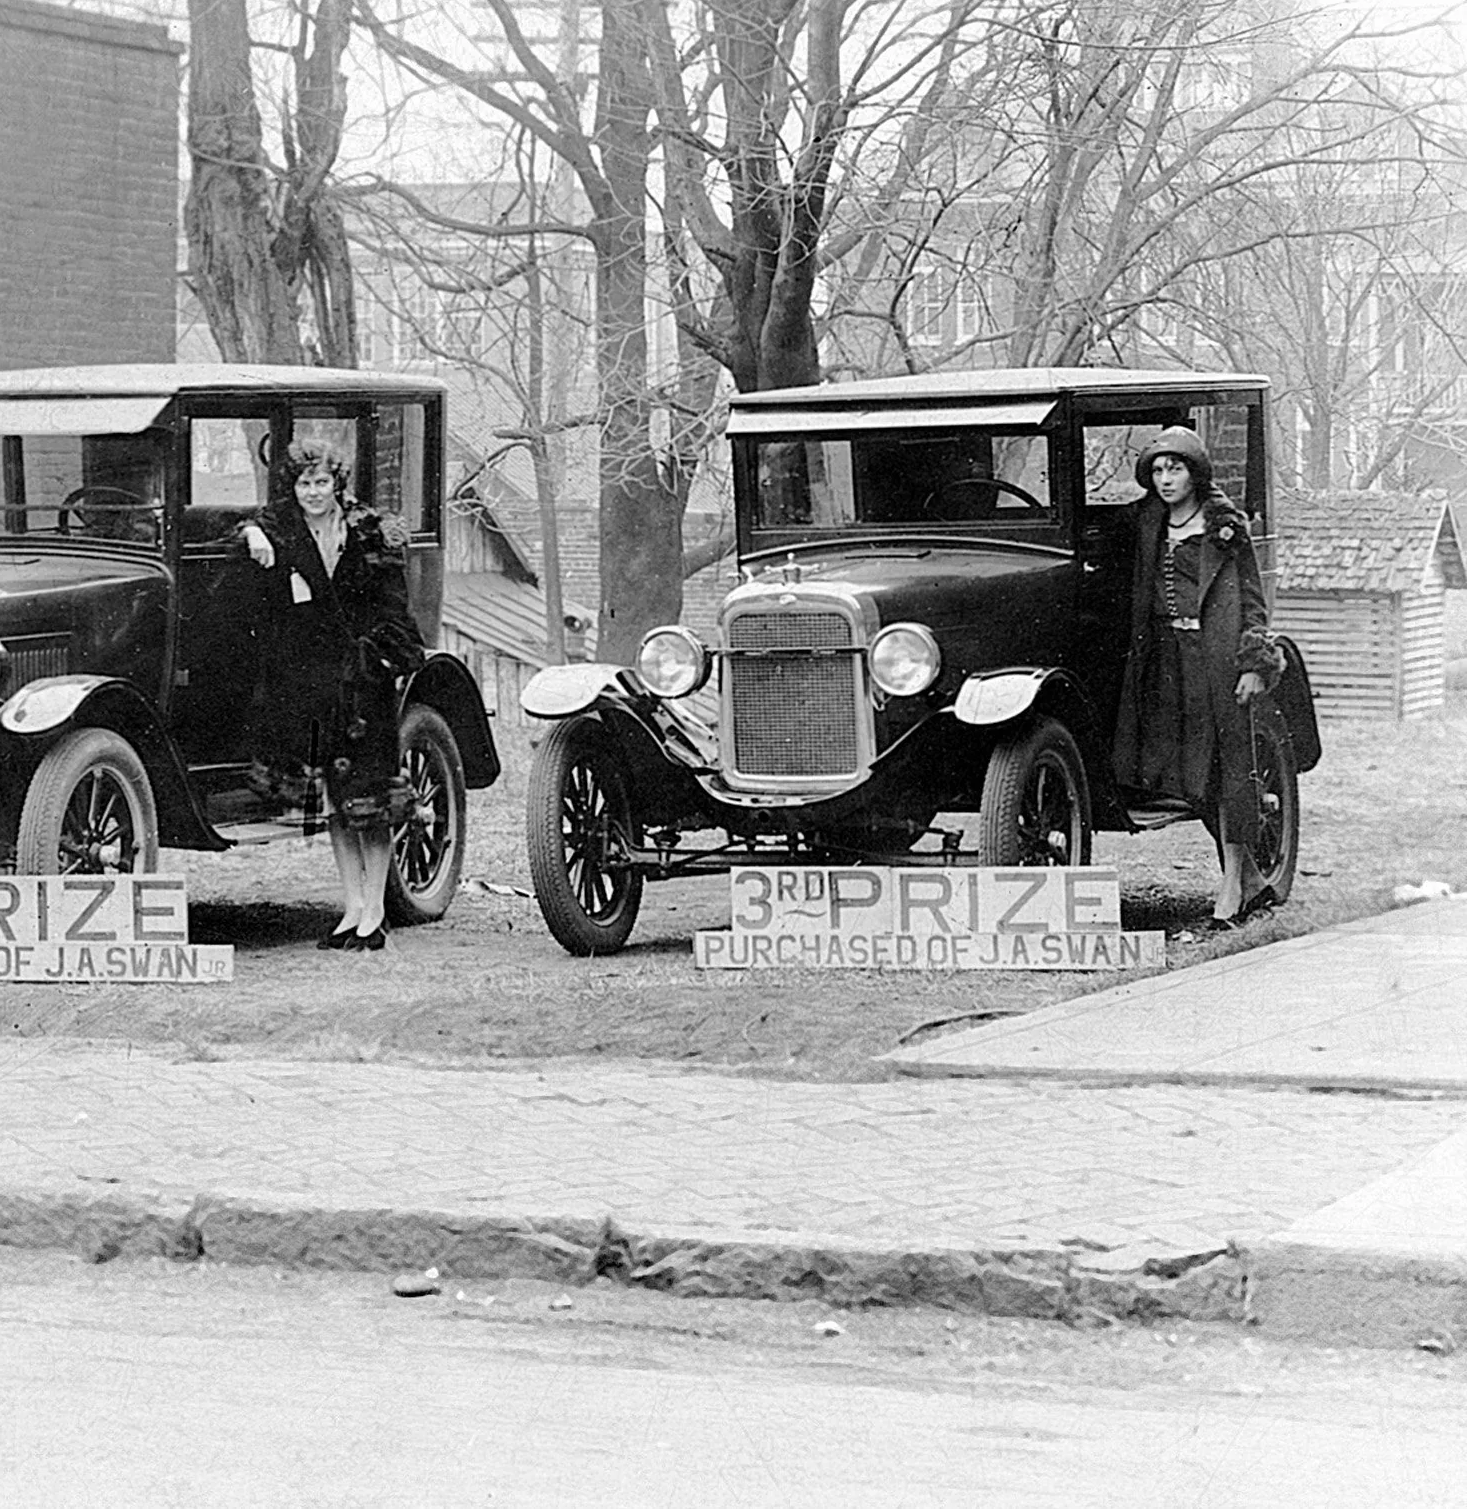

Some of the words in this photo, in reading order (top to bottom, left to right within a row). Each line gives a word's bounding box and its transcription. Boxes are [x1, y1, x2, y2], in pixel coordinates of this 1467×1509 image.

[734, 870, 825, 931] 3RD
[828, 871, 1120, 933] PRIZE
[927, 934, 972, 965] OF
[202, 960, 226, 974] JR
